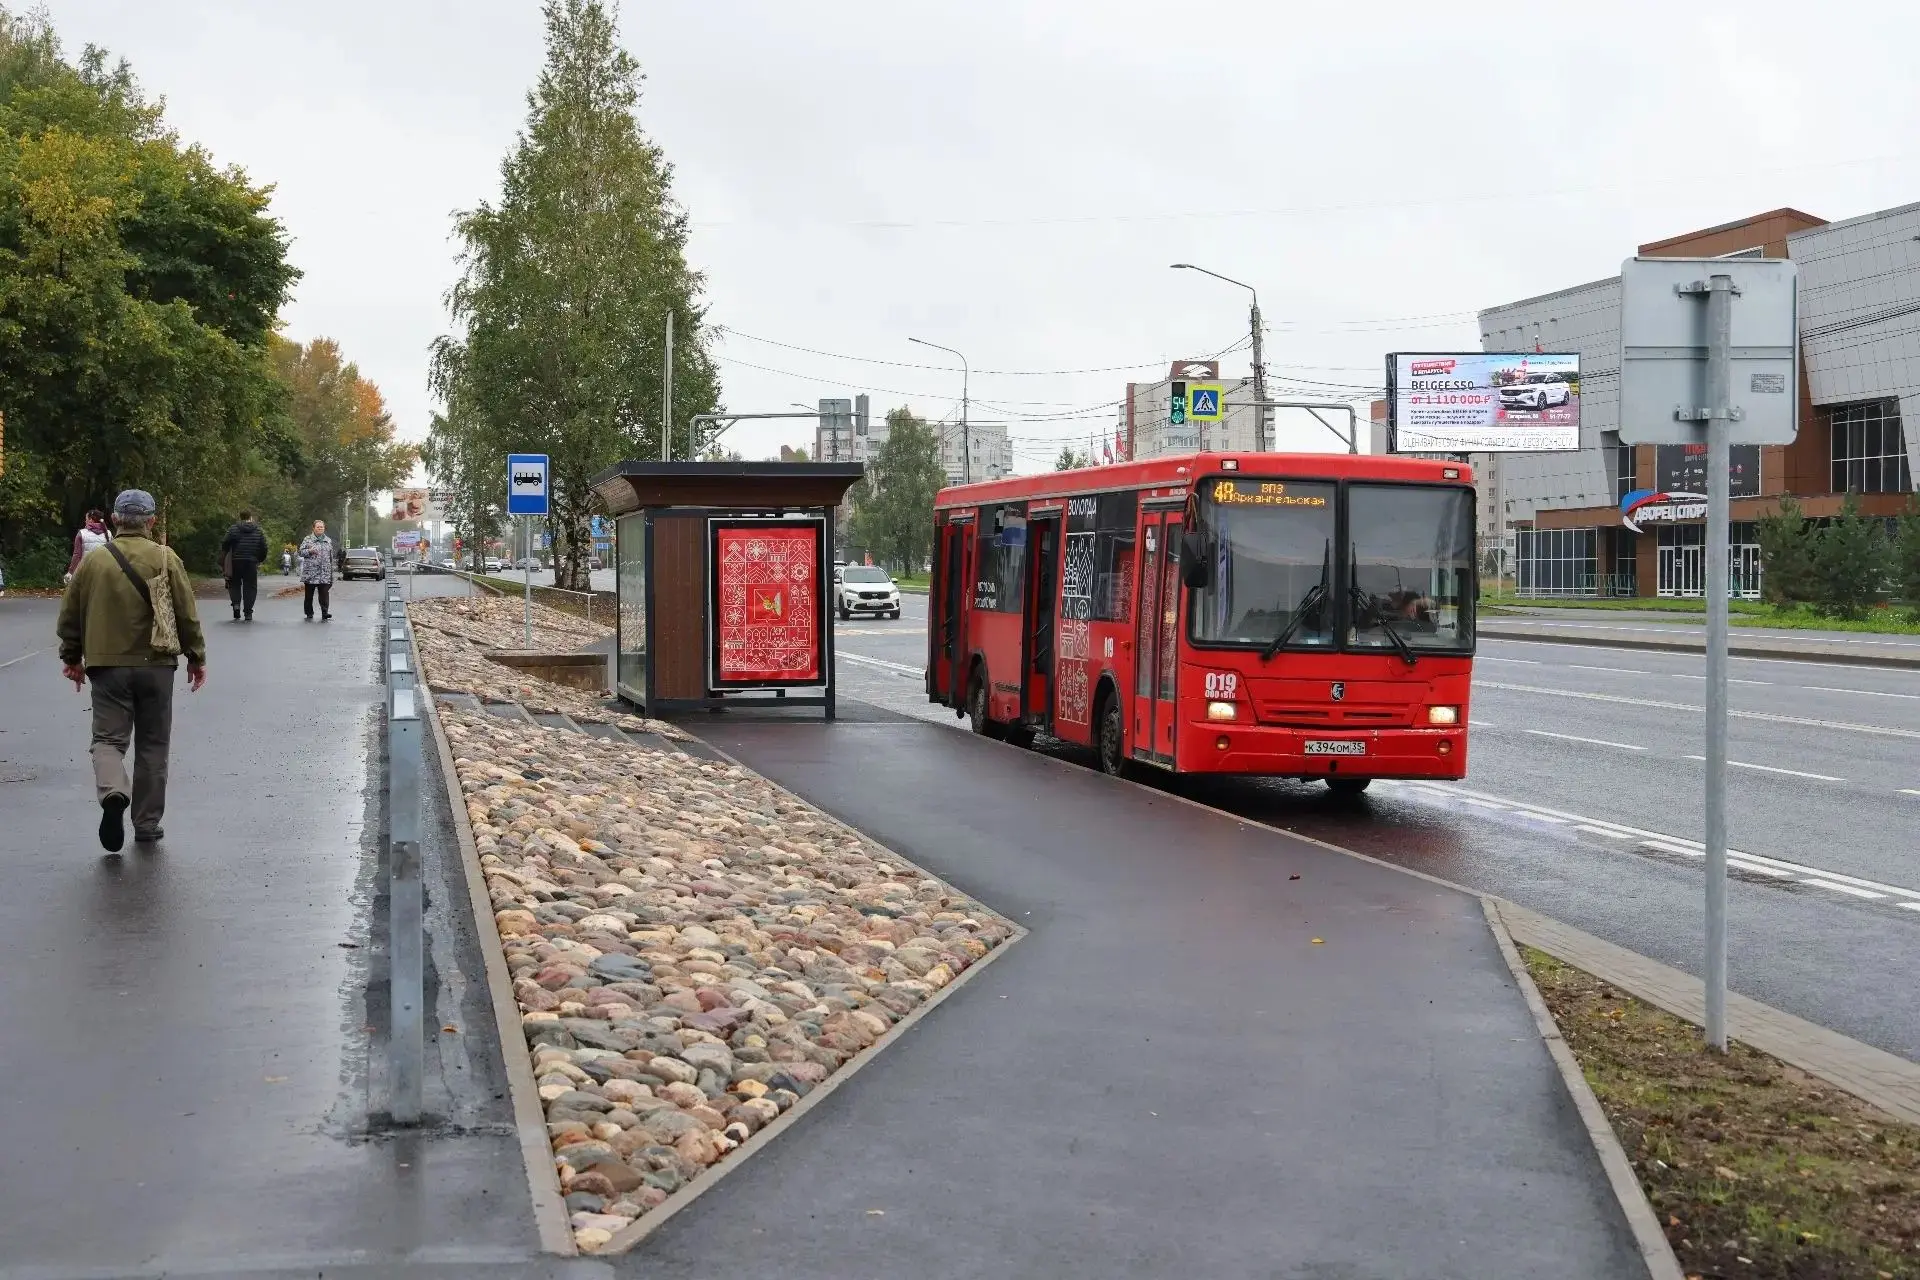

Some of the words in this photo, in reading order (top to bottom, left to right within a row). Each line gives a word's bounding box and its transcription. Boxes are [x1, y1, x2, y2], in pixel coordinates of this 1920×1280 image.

[1411, 380, 1451, 391] BELGEE
[1454, 380, 1474, 391] S50
[1172, 396, 1185, 410] 54
[1261, 483, 1284, 494] ВПЗ
[1232, 493, 1326, 506] Архангельская
[1634, 505, 1677, 523] ДВОРЕЦ
[1677, 503, 1708, 519] СПОРТ
[1104, 636, 1114, 658] 019
[1205, 672, 1237, 691] 019
[1351, 742, 1362, 751] 35
